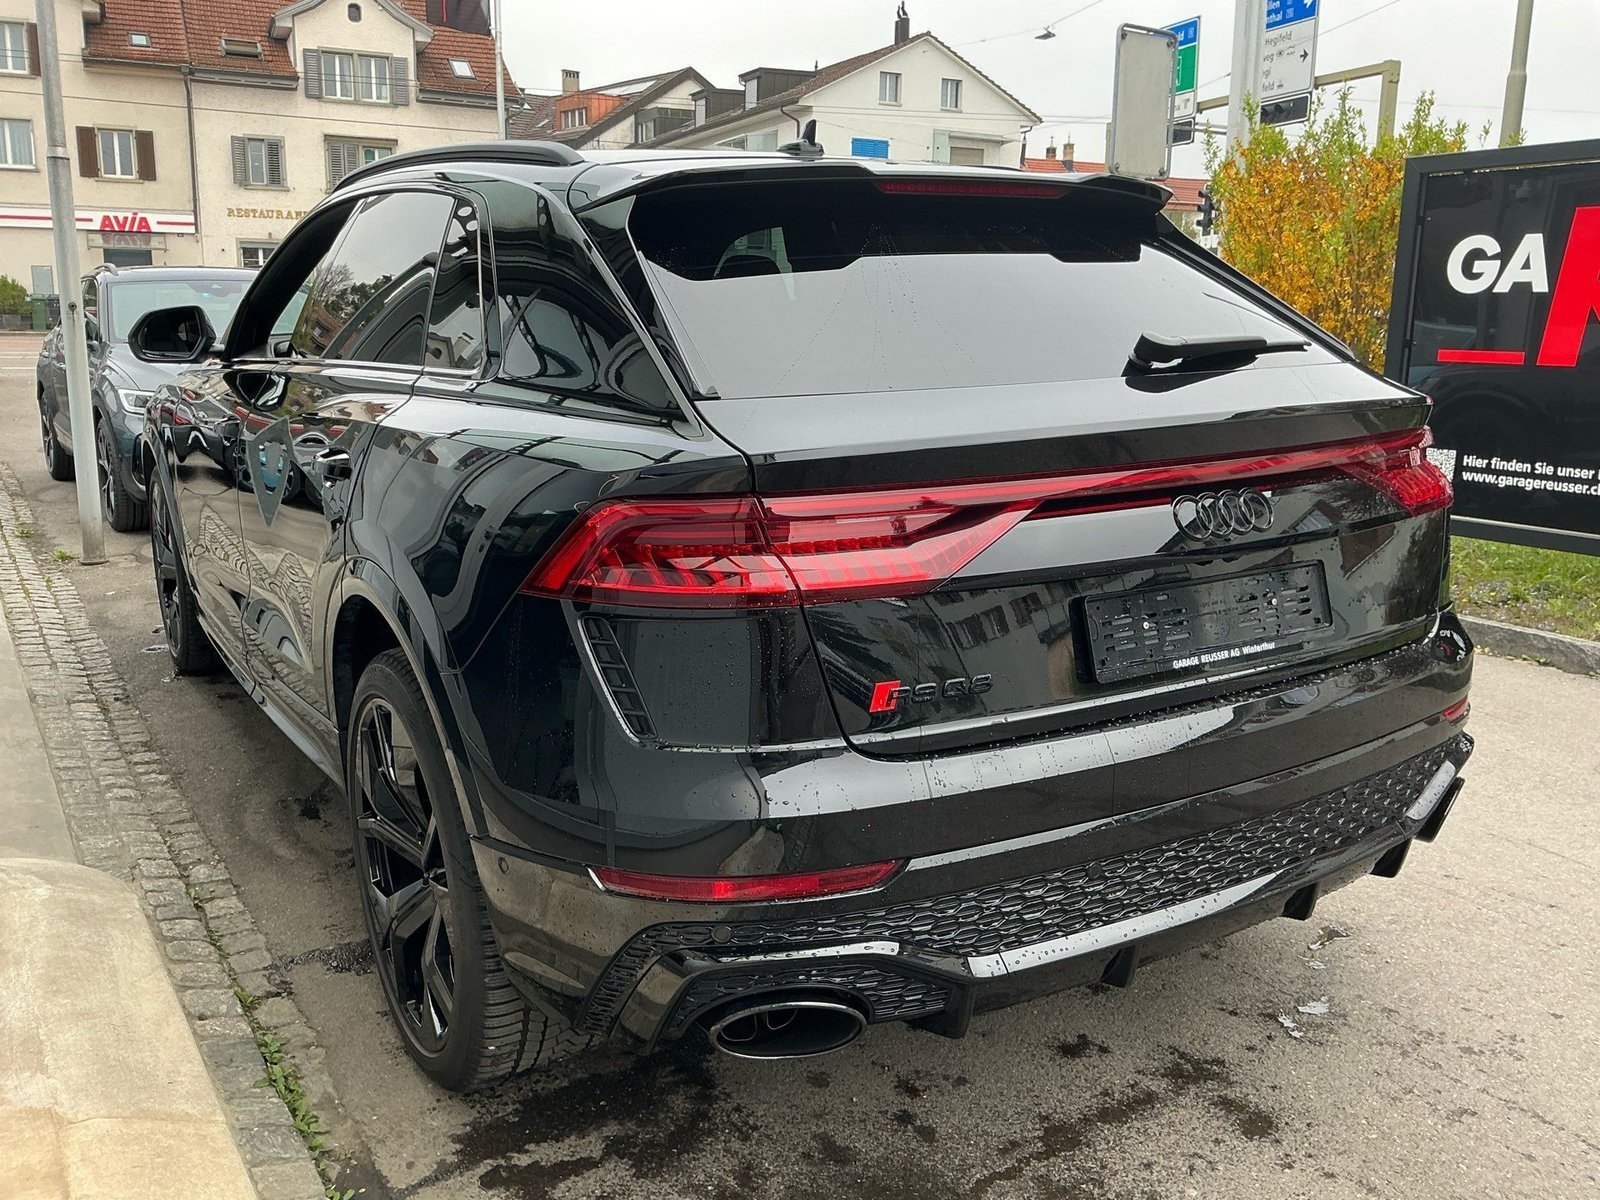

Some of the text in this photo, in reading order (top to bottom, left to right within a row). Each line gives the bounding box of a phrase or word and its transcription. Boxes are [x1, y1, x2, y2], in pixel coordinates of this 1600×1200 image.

[227, 208, 307, 219] RESTAURAN
[1462, 454, 1488, 468] Hier
[1490, 456, 1531, 473] finden
[1534, 461, 1554, 475] Sie
[1556, 466, 1595, 480] unser
[1173, 641, 1275, 669] GARAGE REUSSER AG Winterthur
